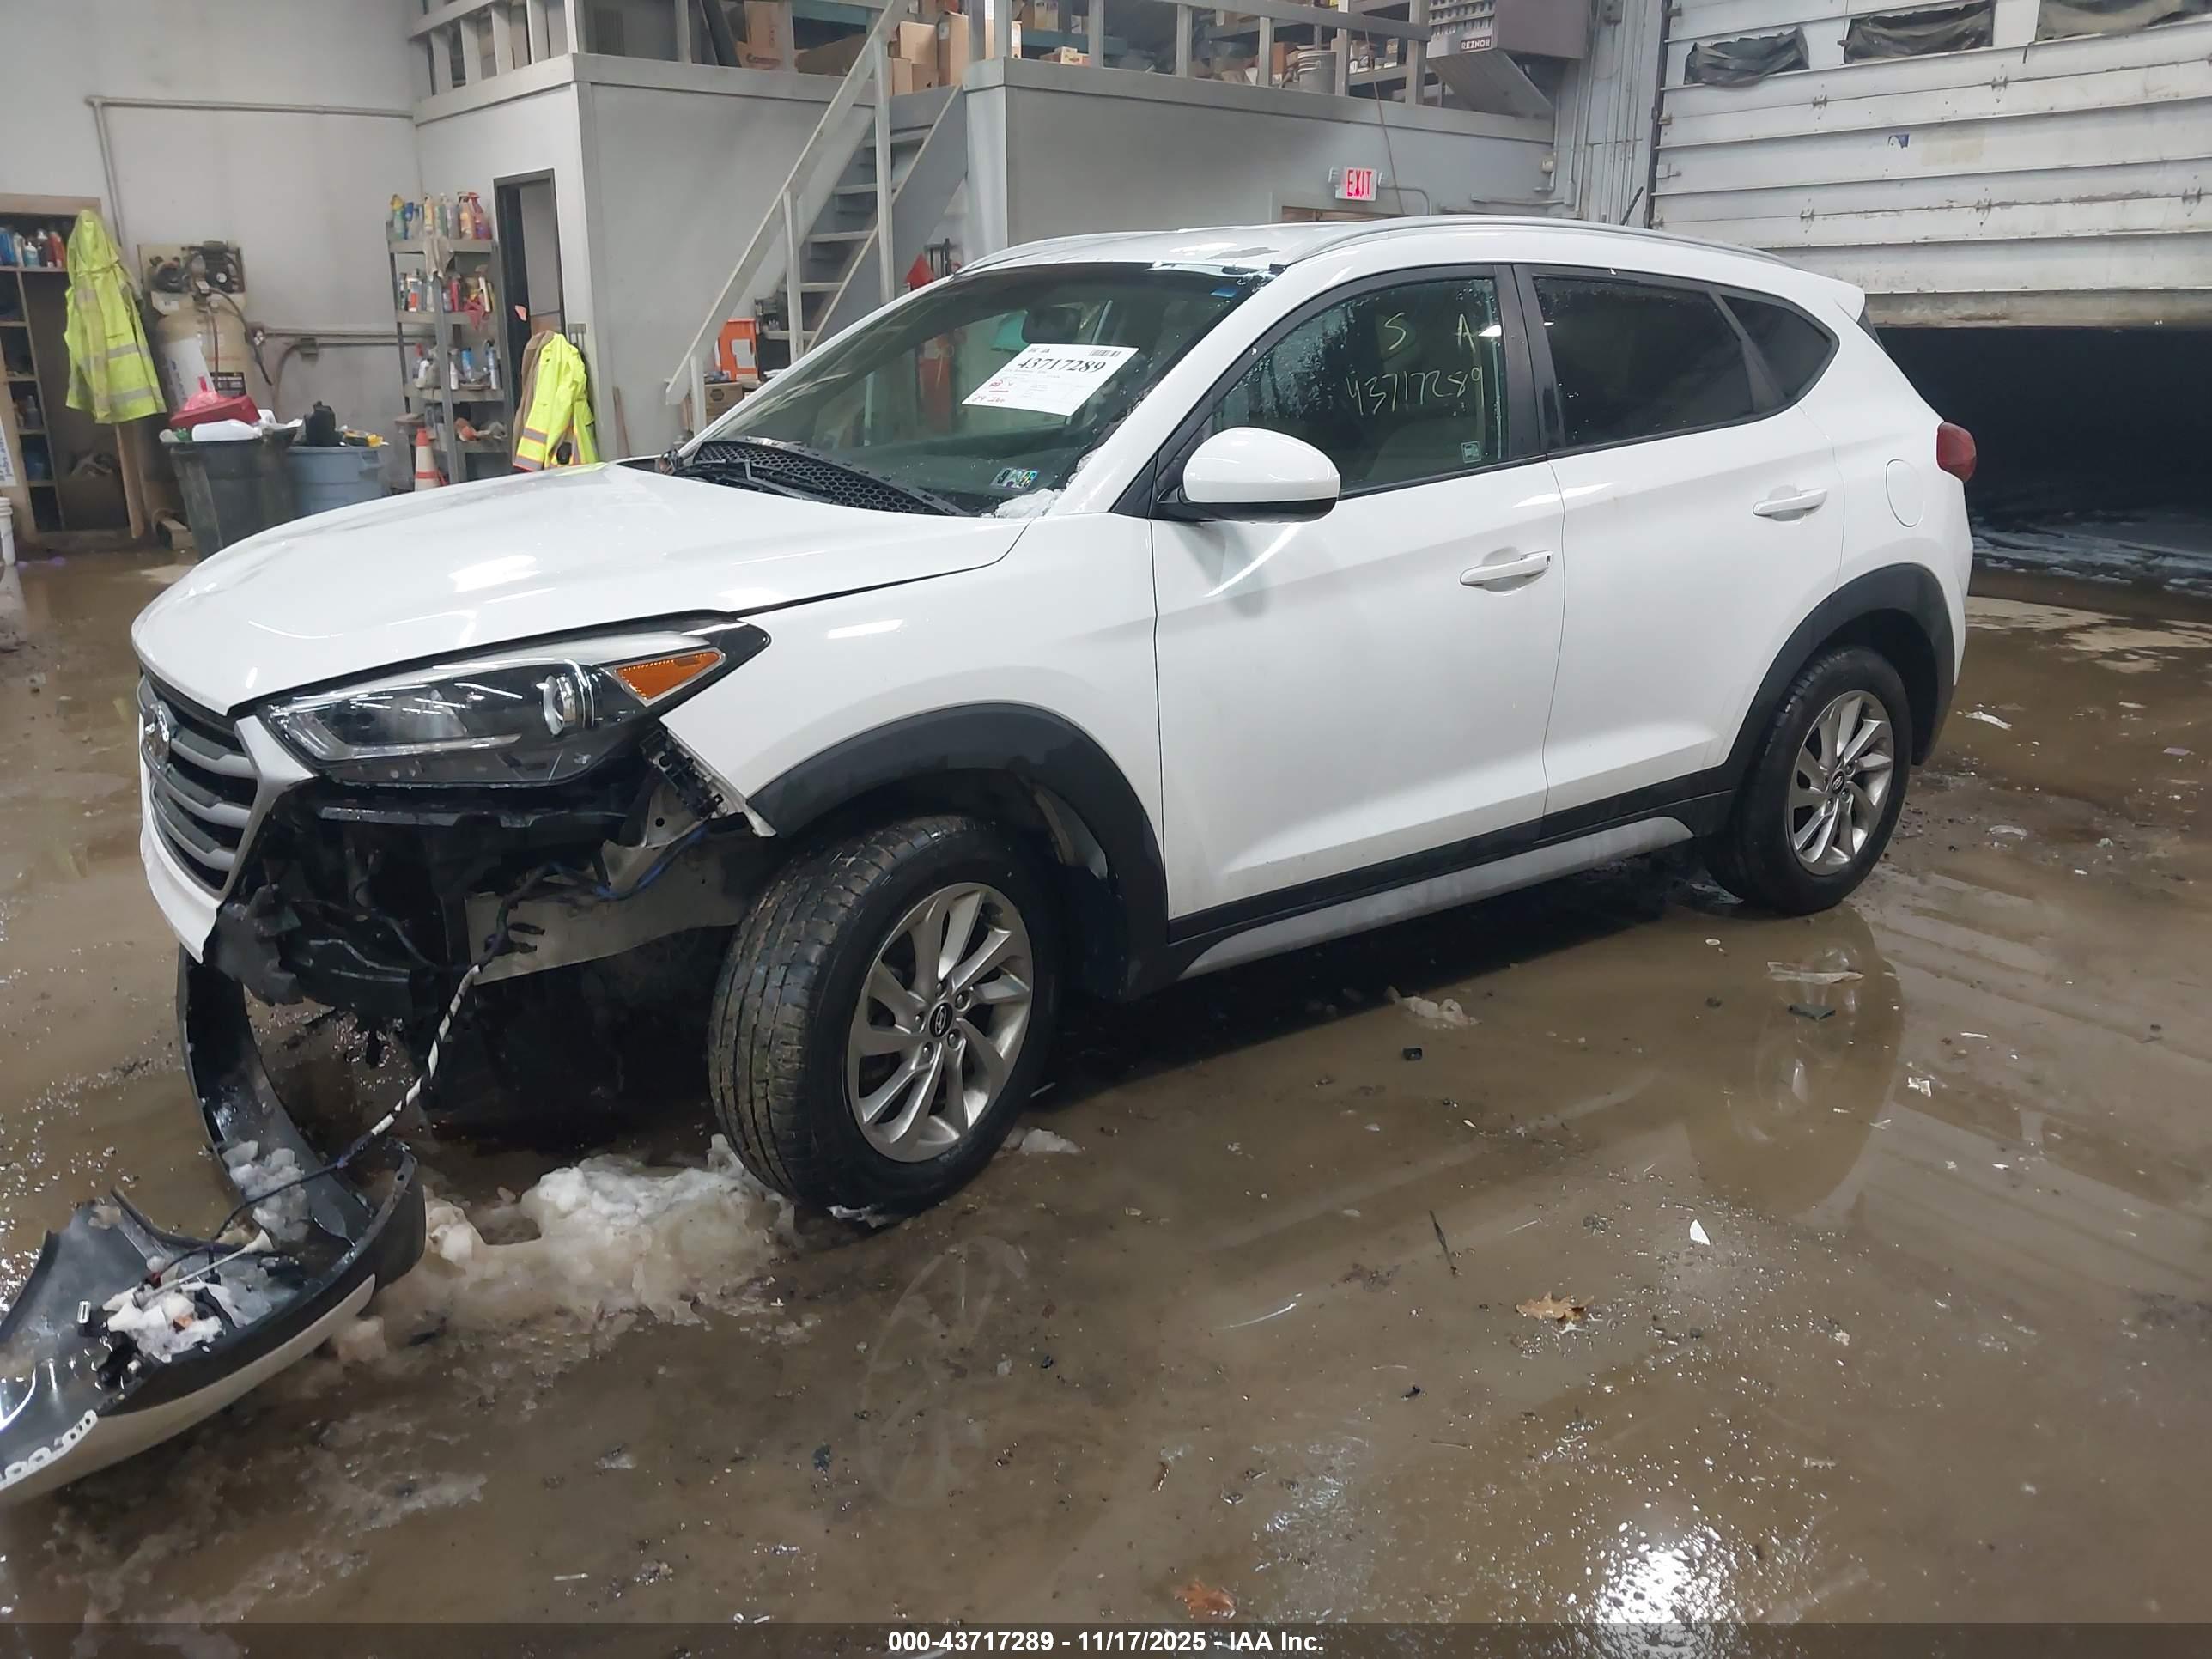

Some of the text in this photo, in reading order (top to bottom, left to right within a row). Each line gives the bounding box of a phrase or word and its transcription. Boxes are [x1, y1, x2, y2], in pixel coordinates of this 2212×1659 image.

[1461, 38, 1491, 50] REZNOR
[1346, 169, 1372, 197] EXIT
[1383, 312, 1476, 352] S A
[1018, 357, 1107, 374] 43717289
[1346, 366, 1486, 416] 43717289
